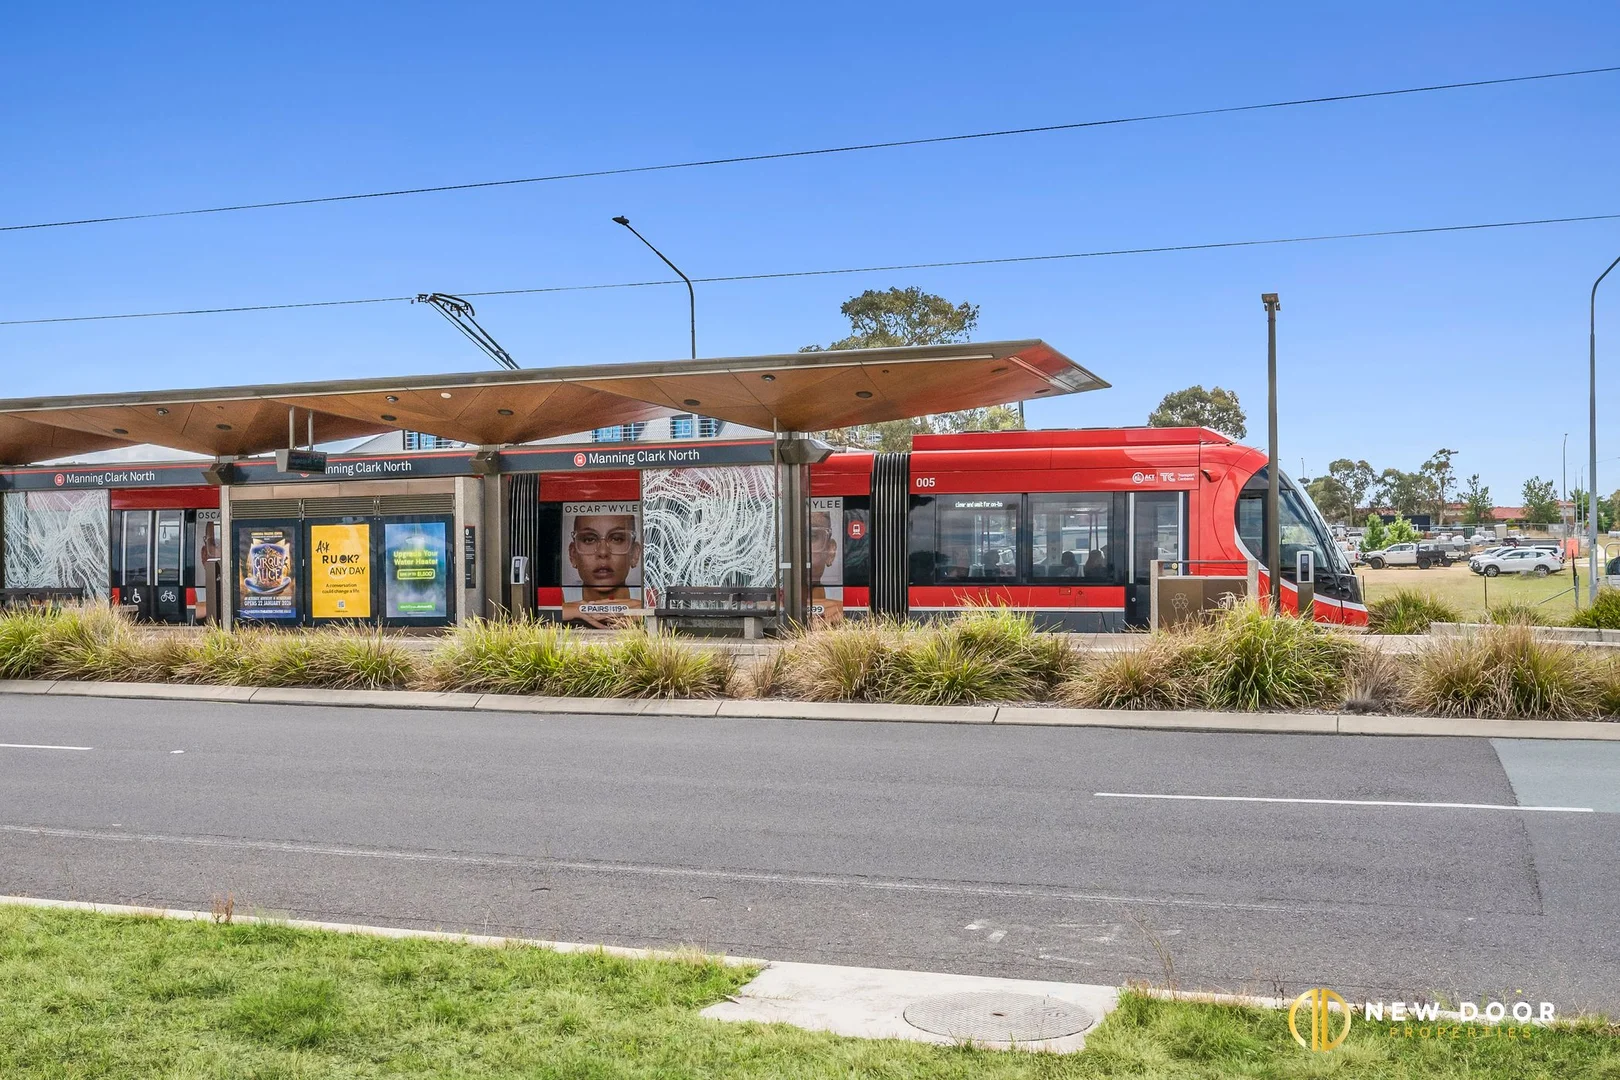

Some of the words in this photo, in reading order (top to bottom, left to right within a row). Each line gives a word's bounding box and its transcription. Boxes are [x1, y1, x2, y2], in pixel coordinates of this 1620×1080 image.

[588, 451, 635, 465] Manning
[637, 450, 666, 462] Clark
[668, 449, 700, 461] North
[325, 463, 354, 476] nning
[355, 461, 381, 473] Clark
[383, 460, 412, 472] North
[66, 473, 103, 485] Manning
[104, 471, 128, 483] Clark
[130, 470, 155, 482] North
[916, 477, 936, 488] 005
[564, 504, 600, 514] OSCAR
[608, 504, 639, 512] WYLE
[316, 540, 330, 554] Ask
[322, 556, 328, 564] R
[330, 555, 338, 564] U
[393, 550, 422, 558] Upgrade
[330, 566, 348, 576] ANY
[349, 566, 366, 575] DAY
